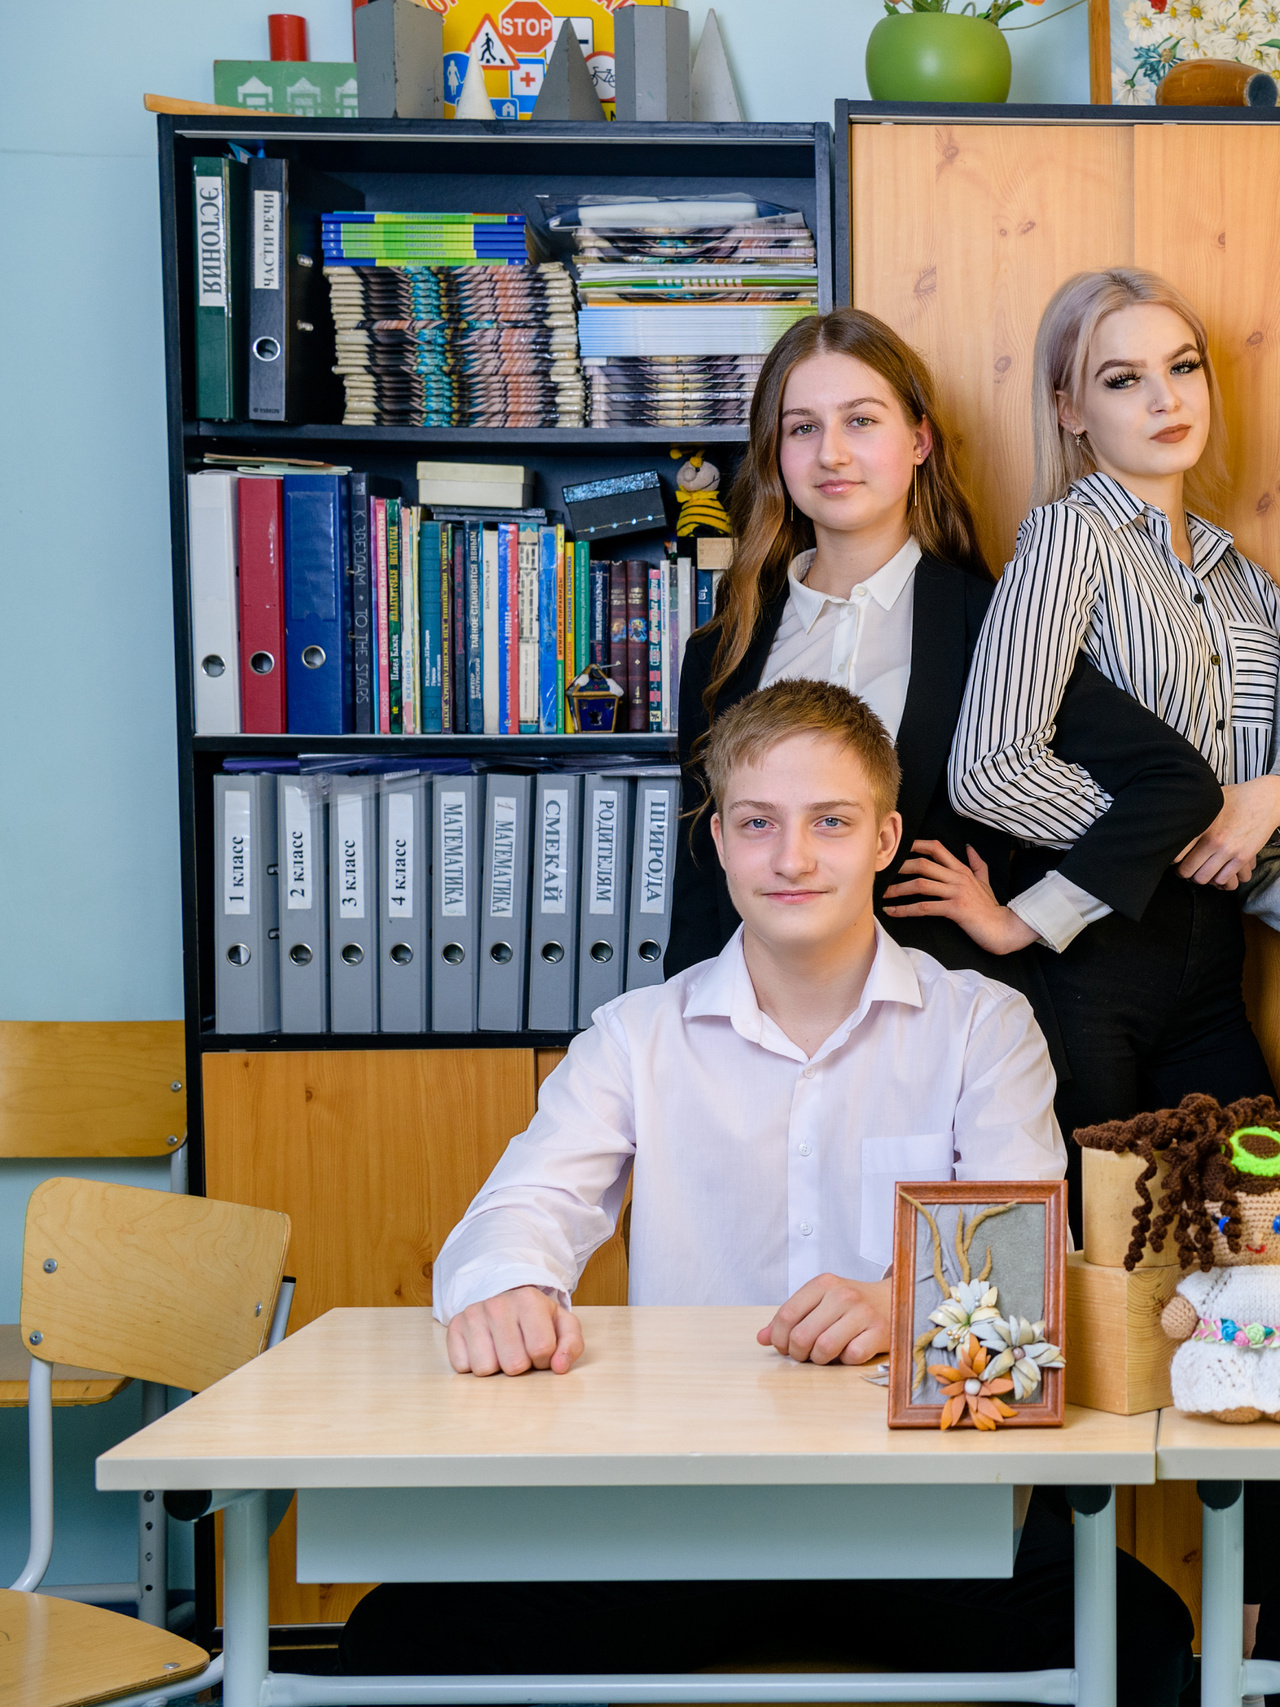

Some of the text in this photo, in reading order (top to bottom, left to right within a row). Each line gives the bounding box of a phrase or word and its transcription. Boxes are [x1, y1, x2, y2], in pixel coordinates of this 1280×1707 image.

[502, 17, 553, 37] STOP
[199, 187, 222, 295] ЭСТОНИЯ
[263, 194, 275, 287] ЧАСТИ РЕЧИ
[389, 525, 399, 622] МАЛАХИТОВАЯ ШКАТУЛКА
[469, 530, 479, 649] ТАЙНОЕ СТАНОВИТСЯ ЯВНЫМ
[355, 608, 369, 704] TO THE STARS
[390, 634, 400, 681] Павел Бажов
[441, 531, 451, 729] ПРАВИЛА ПОВЕДЕНИЯ ДЛЯ ВОСПИТАННЫХ ДЕТЕЙ
[232, 836, 244, 887] класс
[289, 831, 305, 898] 2 класс
[341, 839, 357, 907] 3 класс
[391, 839, 407, 906] 4 класс
[443, 803, 464, 906] МАТЕМАТИКА
[492, 820, 514, 914] МАТЕМАТИКА
[544, 799, 563, 903] СМЕКАЙ
[595, 799, 615, 902] РОДИТЕЛЯМ
[644, 800, 666, 903] ПРИРОДА
